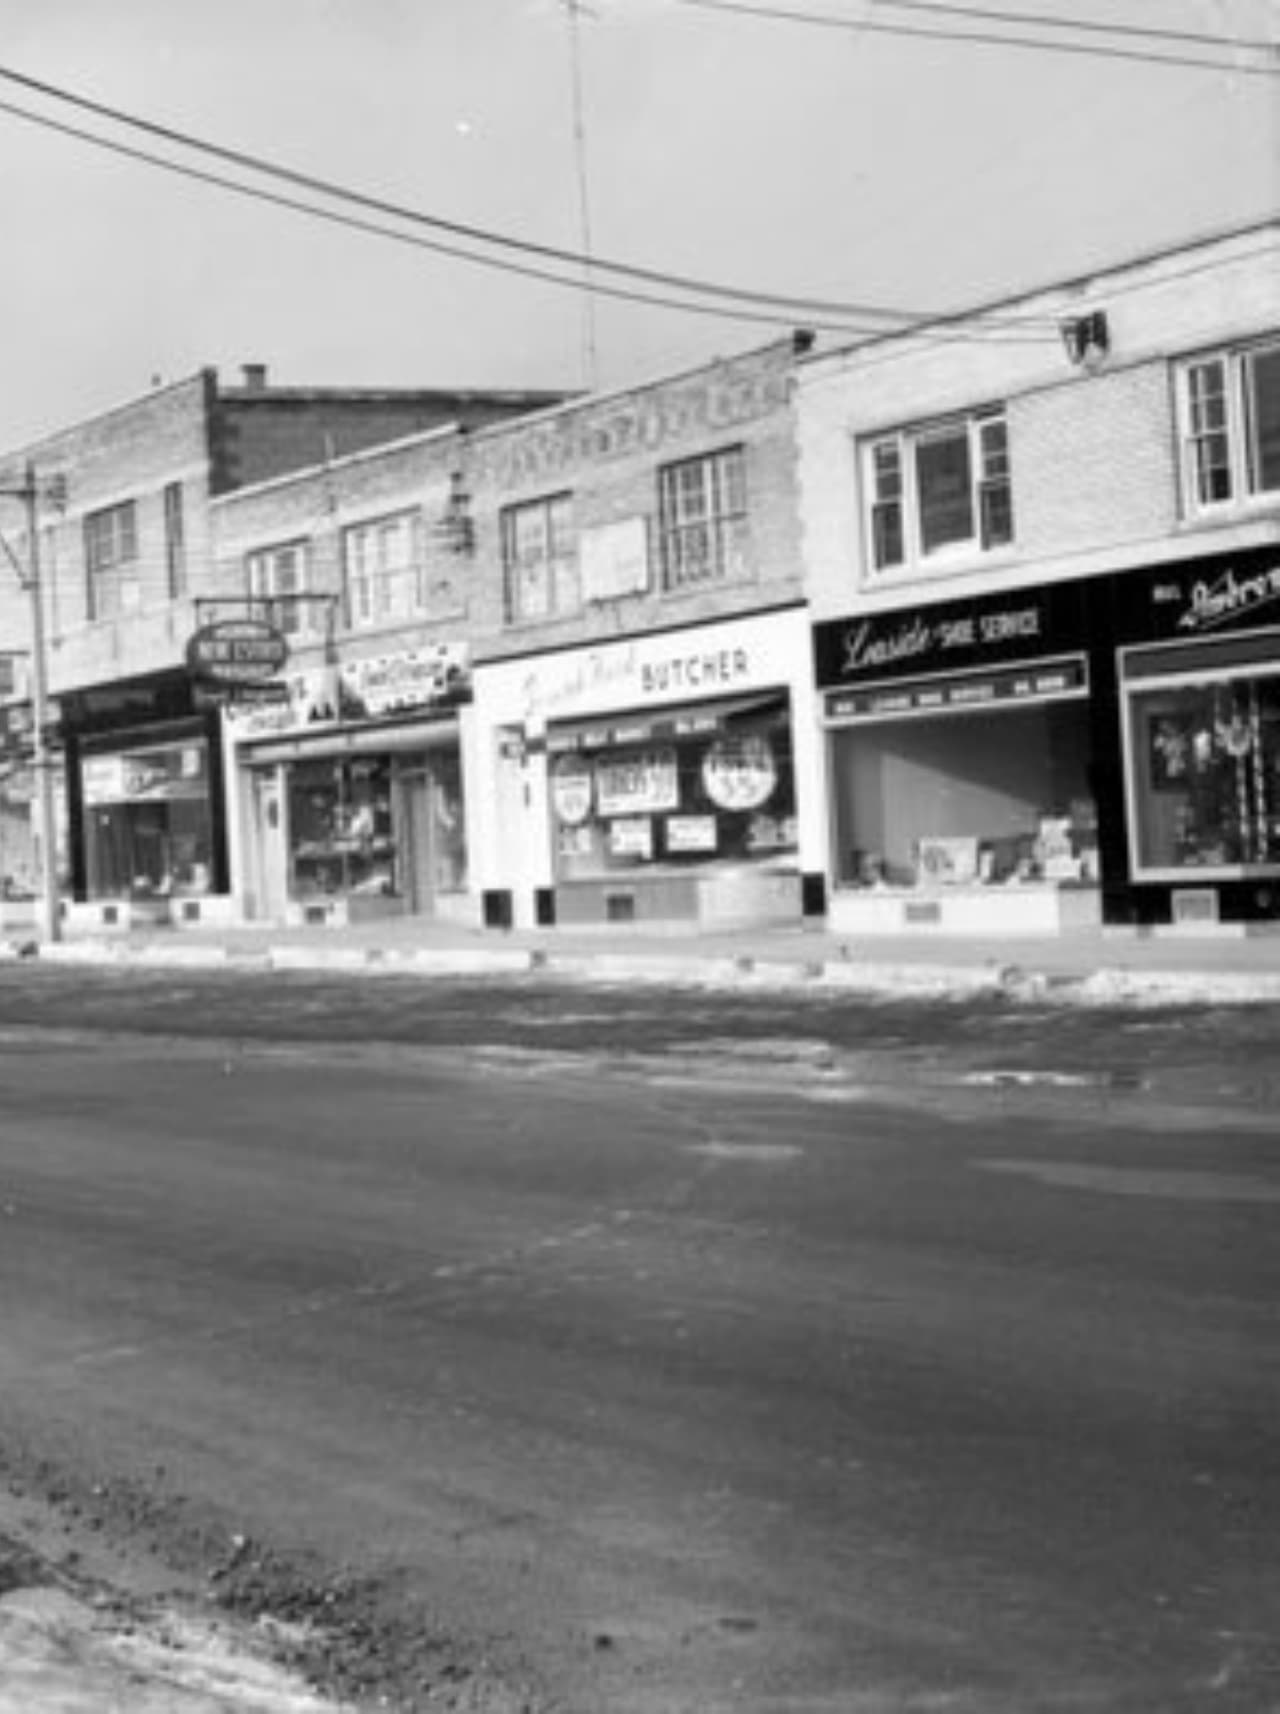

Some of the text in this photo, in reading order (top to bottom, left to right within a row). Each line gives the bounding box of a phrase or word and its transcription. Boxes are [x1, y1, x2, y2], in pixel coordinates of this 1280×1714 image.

[641, 646, 749, 693] BUTCHER
[840, 607, 1040, 675] Leaside SHOE SERVICE
